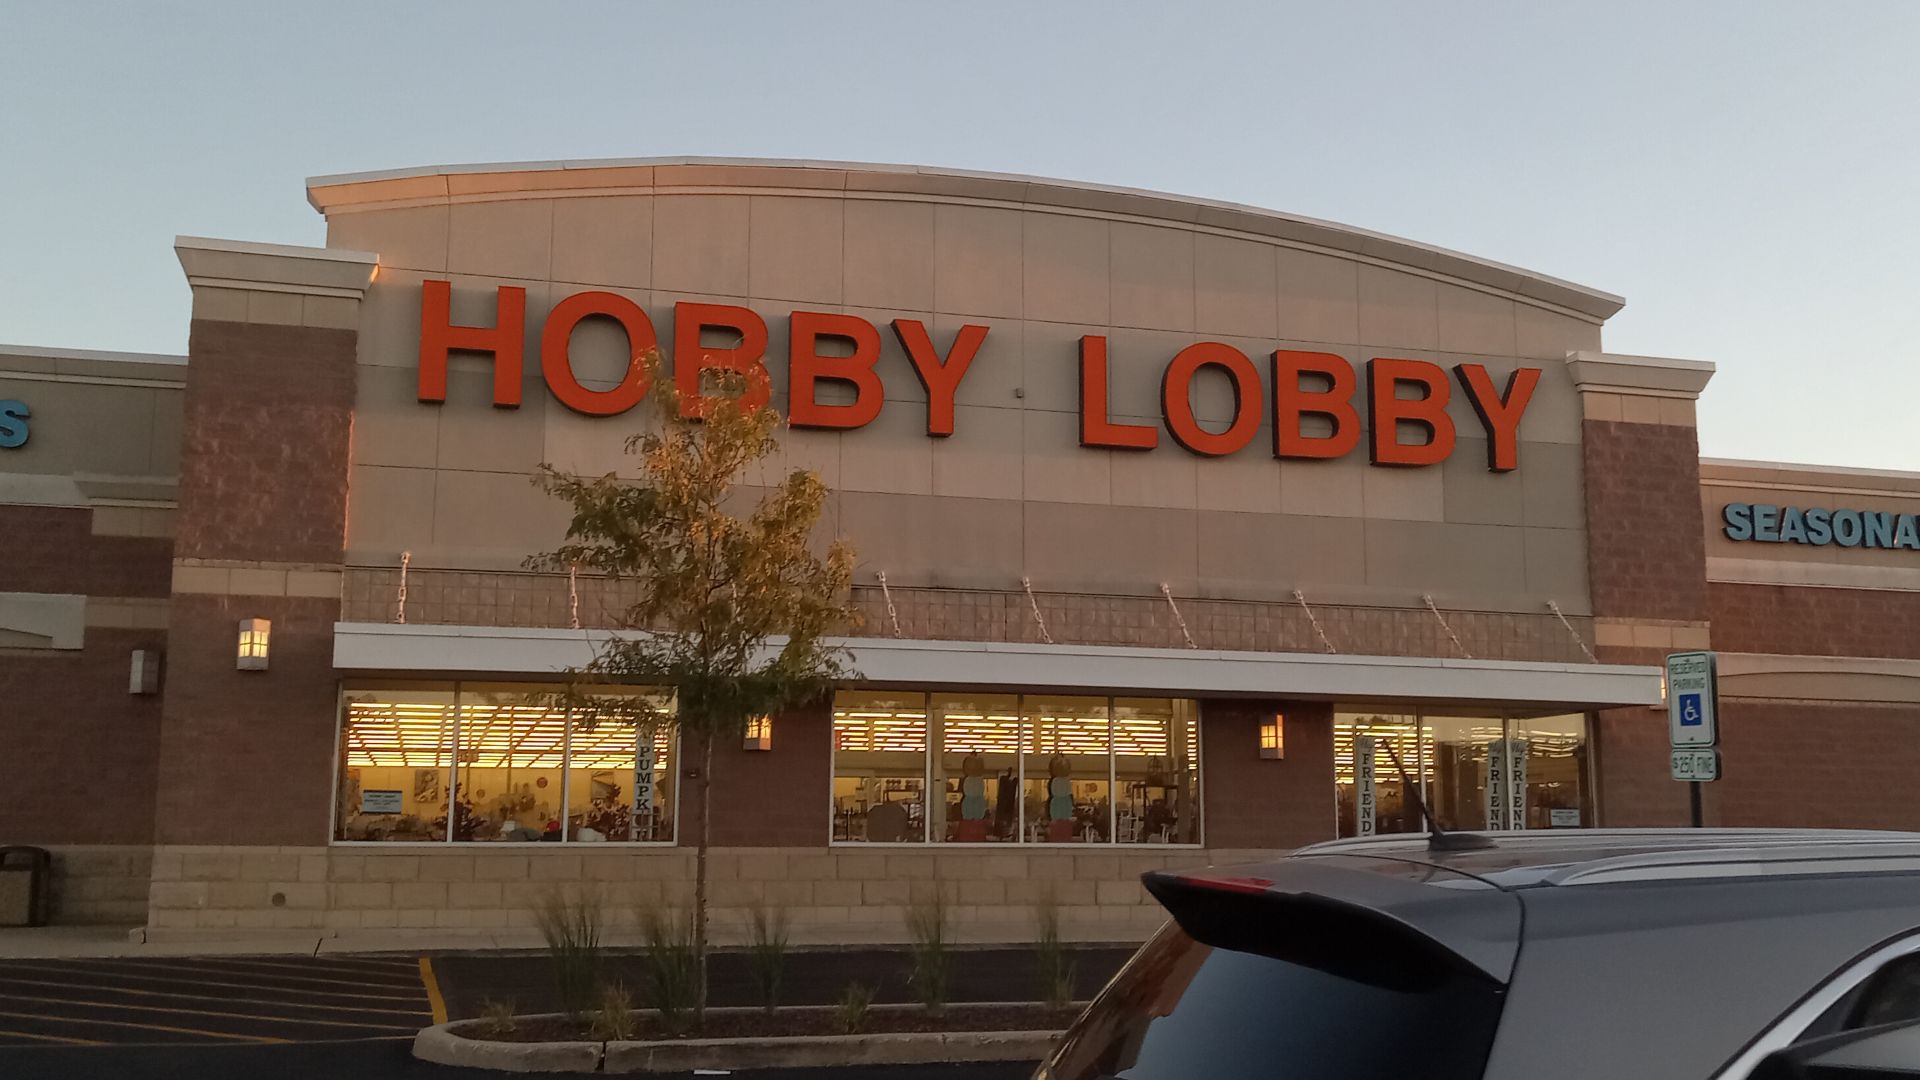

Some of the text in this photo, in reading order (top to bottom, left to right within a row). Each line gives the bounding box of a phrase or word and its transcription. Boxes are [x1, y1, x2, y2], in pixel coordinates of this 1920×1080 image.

[418, 280, 1543, 473] HOBBY LOBBY
[1723, 503, 1920, 550] SEASONA
[636, 746, 652, 841] PUMPK
[1361, 753, 1373, 836] FRIEND
